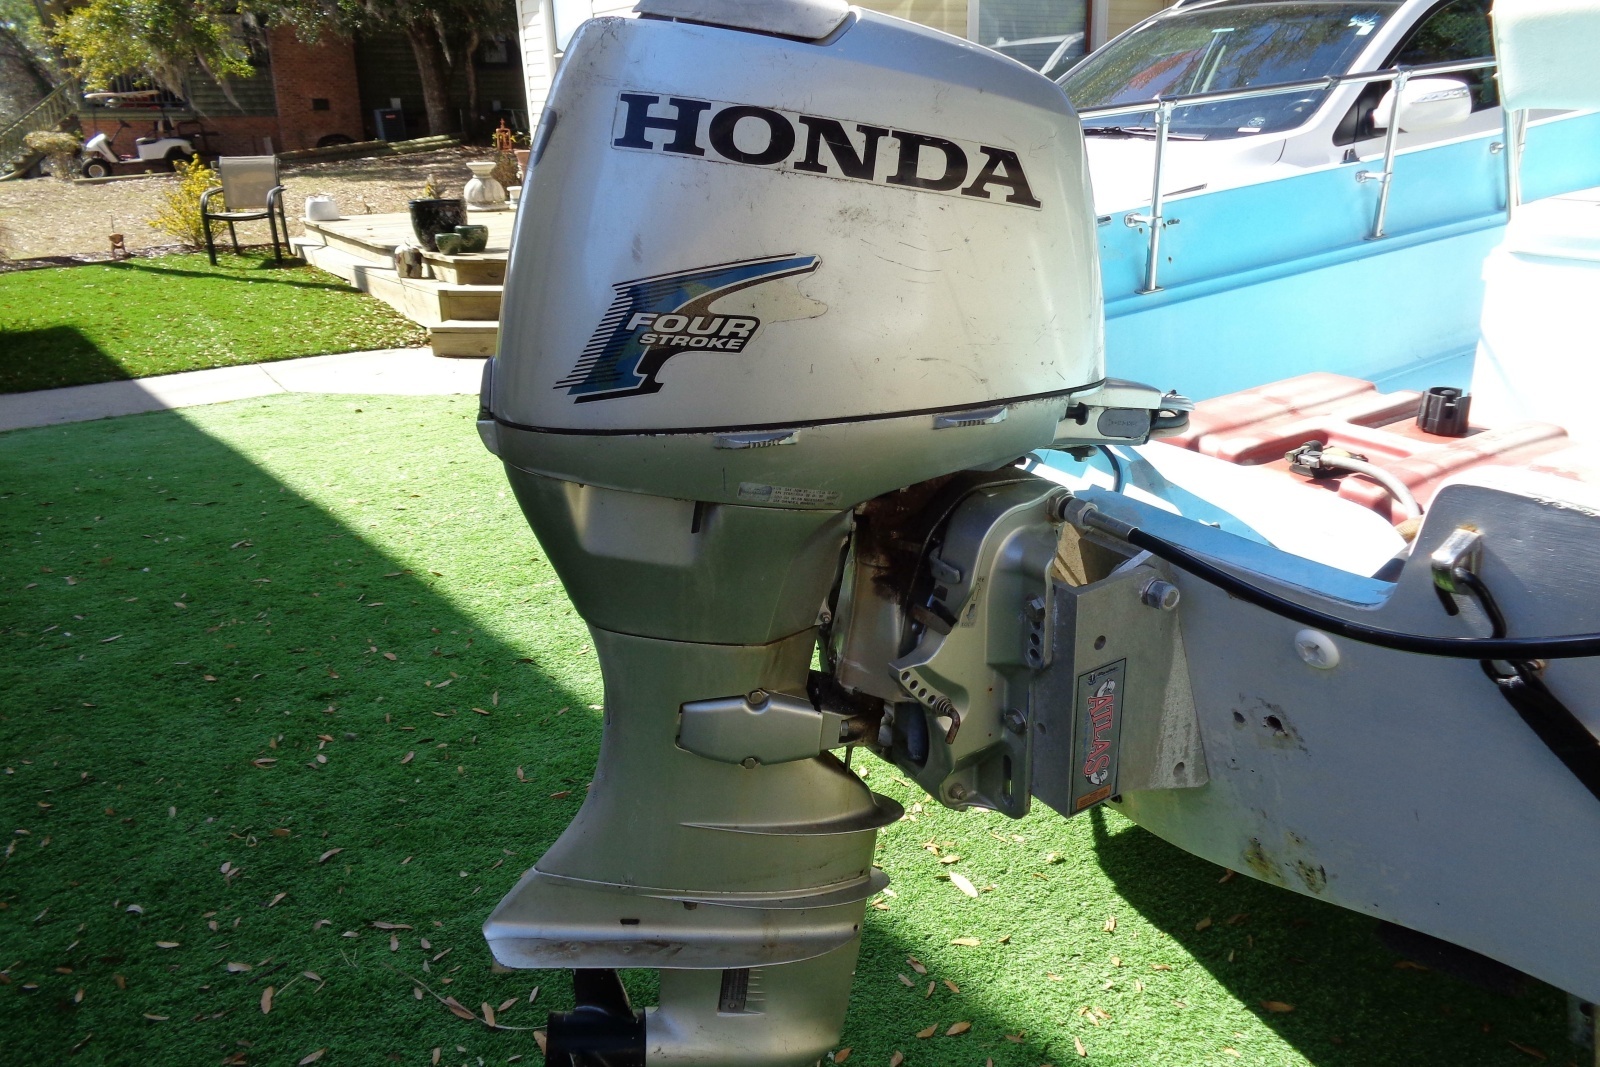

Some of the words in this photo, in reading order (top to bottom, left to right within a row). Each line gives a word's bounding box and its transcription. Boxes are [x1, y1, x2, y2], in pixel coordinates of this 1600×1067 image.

[613, 93, 1042, 208] HONDA
[625, 312, 757, 338] FOUR
[639, 333, 745, 350] STROKE
[1083, 694, 1115, 776] ATLAS
